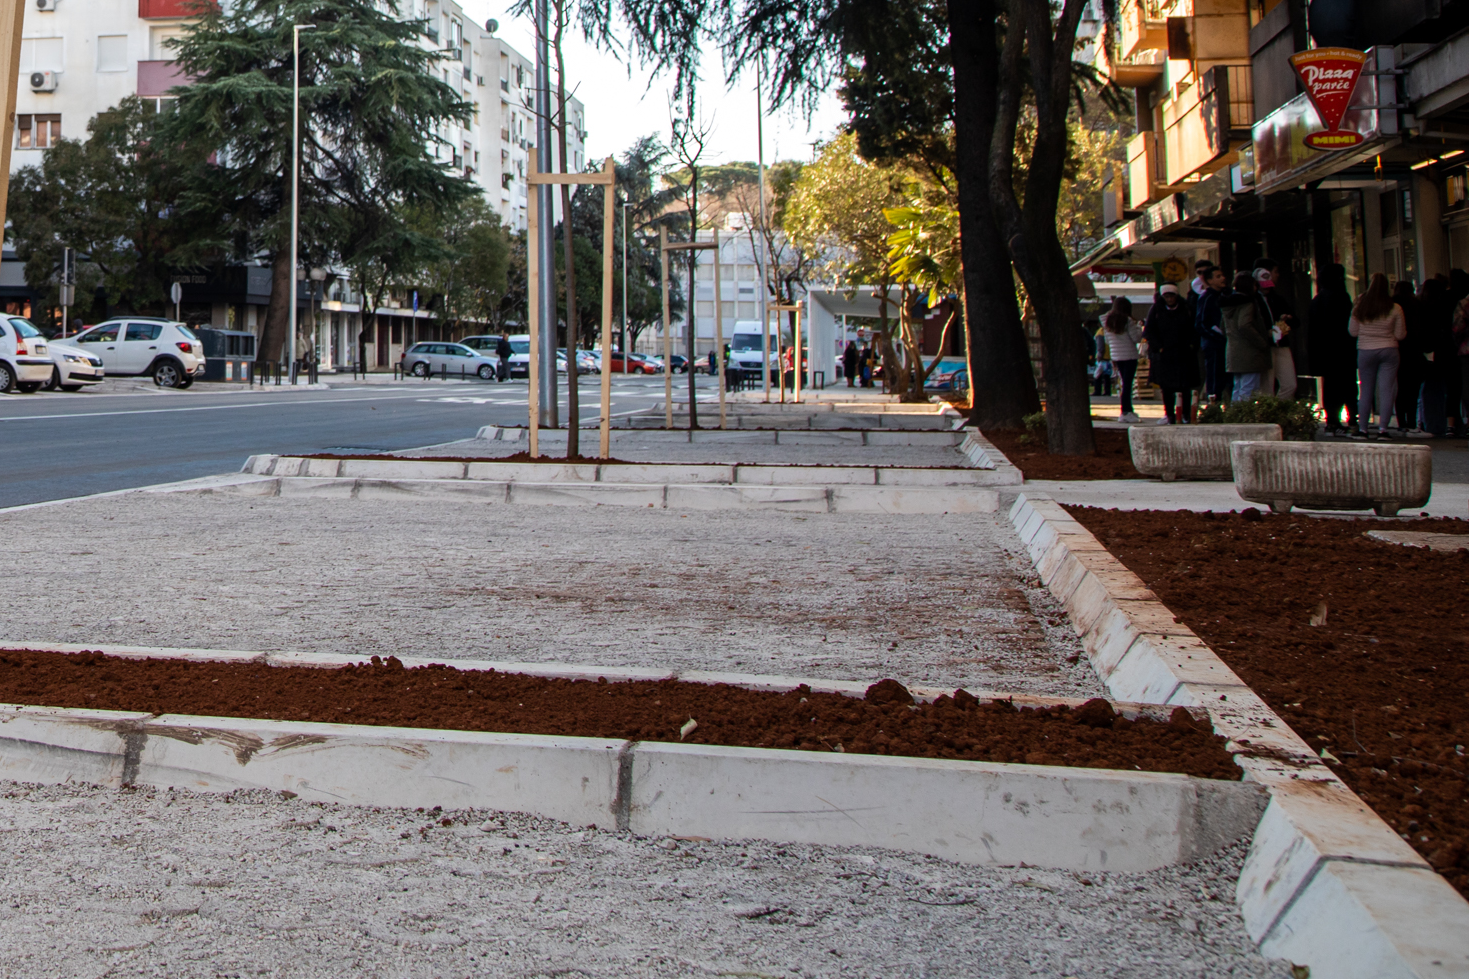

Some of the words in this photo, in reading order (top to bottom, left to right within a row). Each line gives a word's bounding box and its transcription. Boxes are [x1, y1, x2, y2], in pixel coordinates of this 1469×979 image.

[1315, 51, 1327, 59] you
[1346, 51, 1364, 61] ready
[1300, 65, 1355, 86] Pizza
[1312, 80, 1350, 95] parče
[1312, 135, 1356, 145] MIMI
